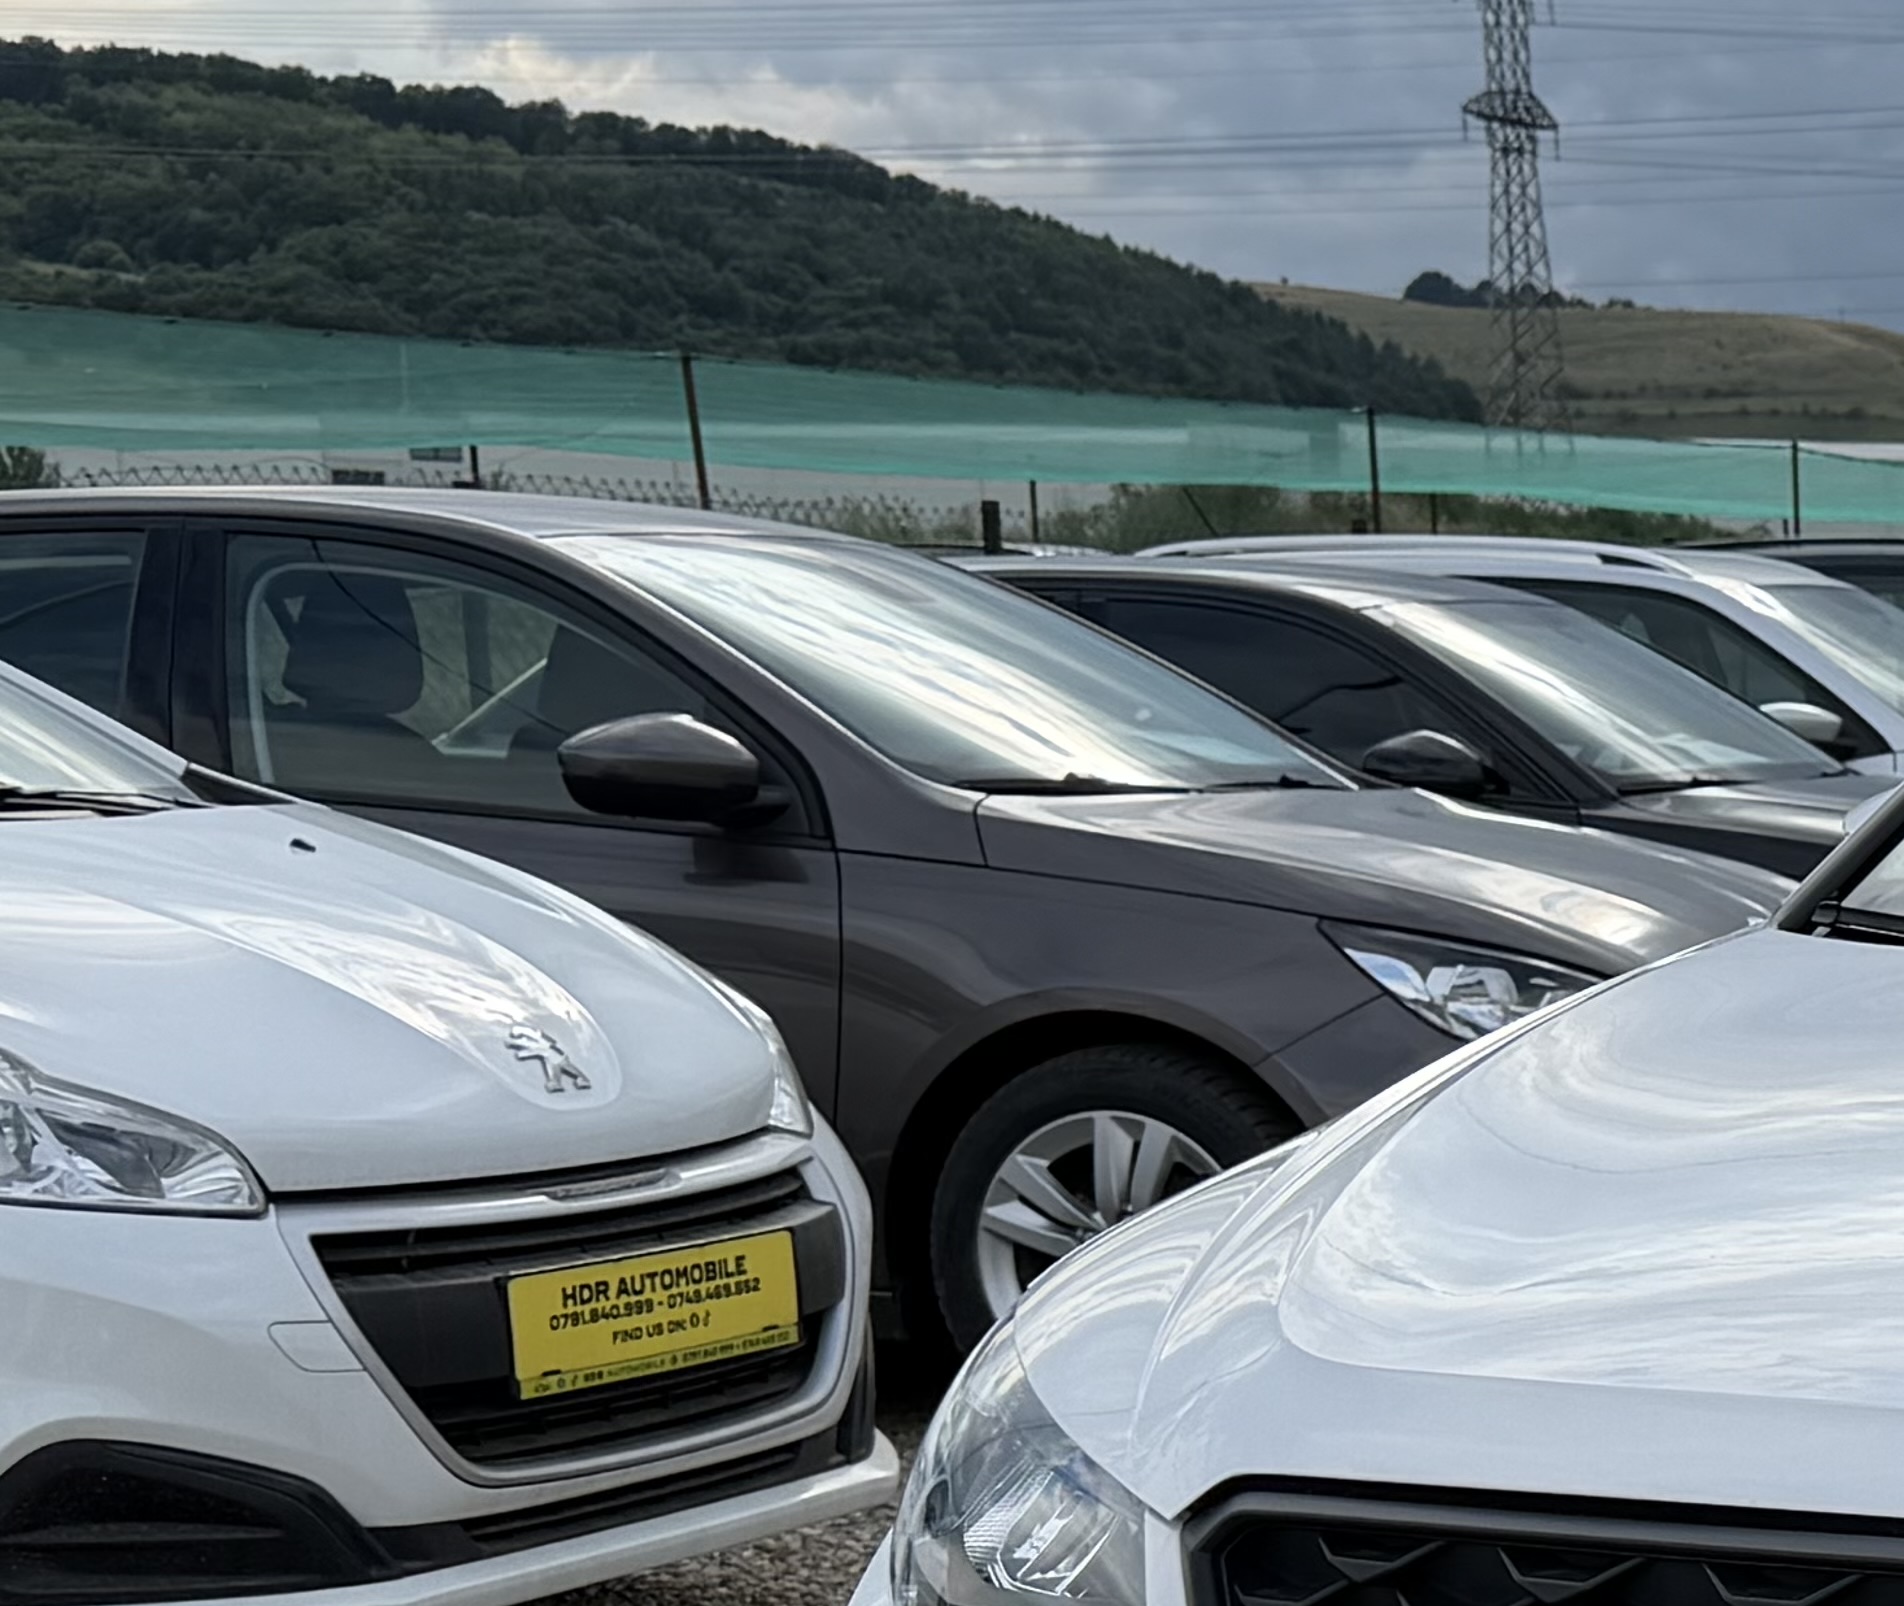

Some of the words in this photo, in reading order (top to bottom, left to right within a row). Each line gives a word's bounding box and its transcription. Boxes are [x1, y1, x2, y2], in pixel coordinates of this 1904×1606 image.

[562, 1280, 610, 1309] HDR
[616, 1255, 748, 1300] AUTOMOBILE
[612, 1327, 643, 1345] FIND
